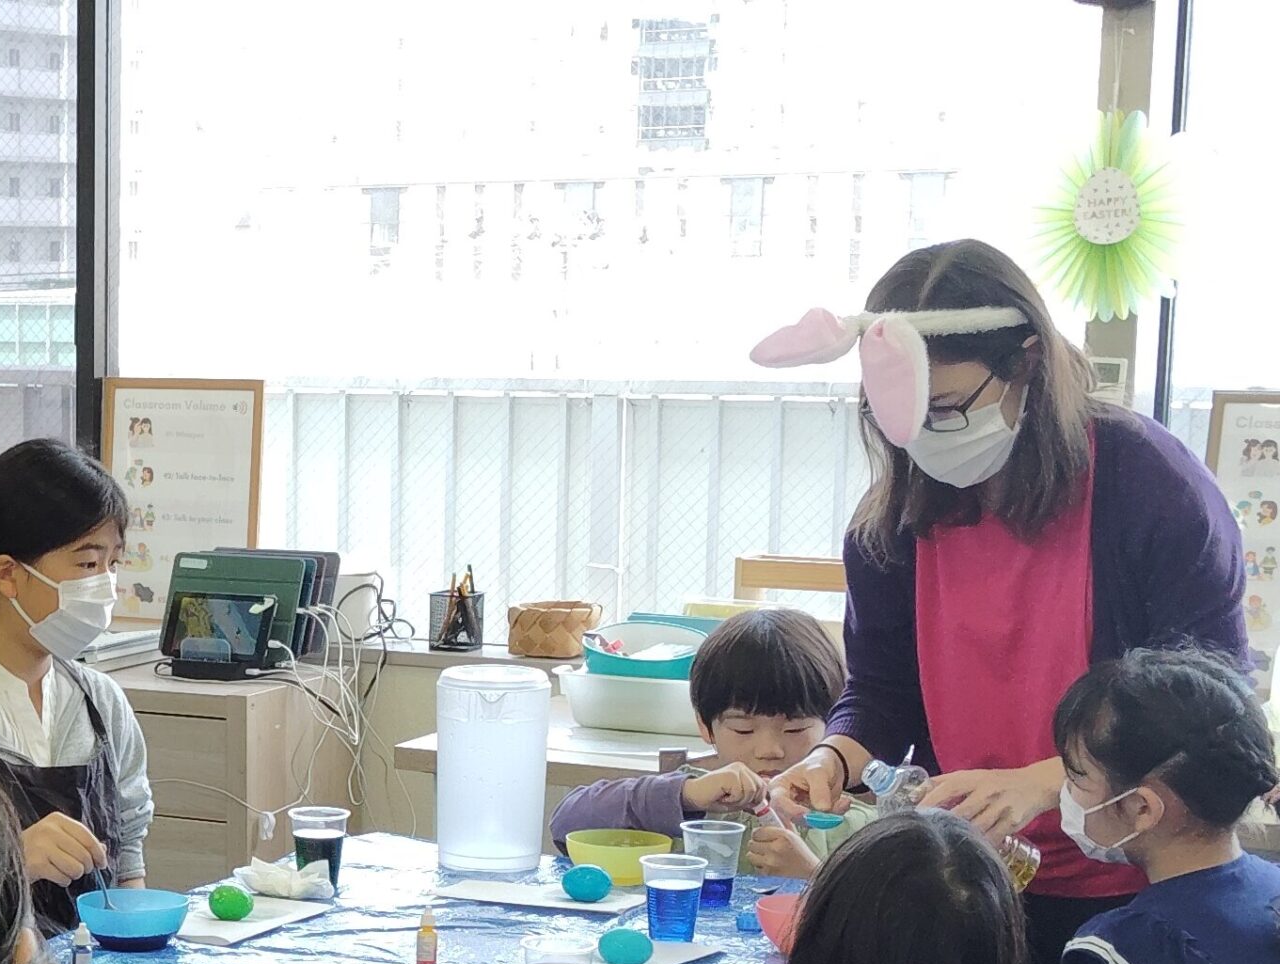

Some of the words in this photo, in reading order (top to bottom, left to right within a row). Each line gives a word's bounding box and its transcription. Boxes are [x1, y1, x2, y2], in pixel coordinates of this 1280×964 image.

[1087, 196, 1127, 208] HAPPY
[1083, 207, 1132, 220] EASTER!
[124, 398, 181, 411] Classroom
[184, 399, 226, 411] Volume
